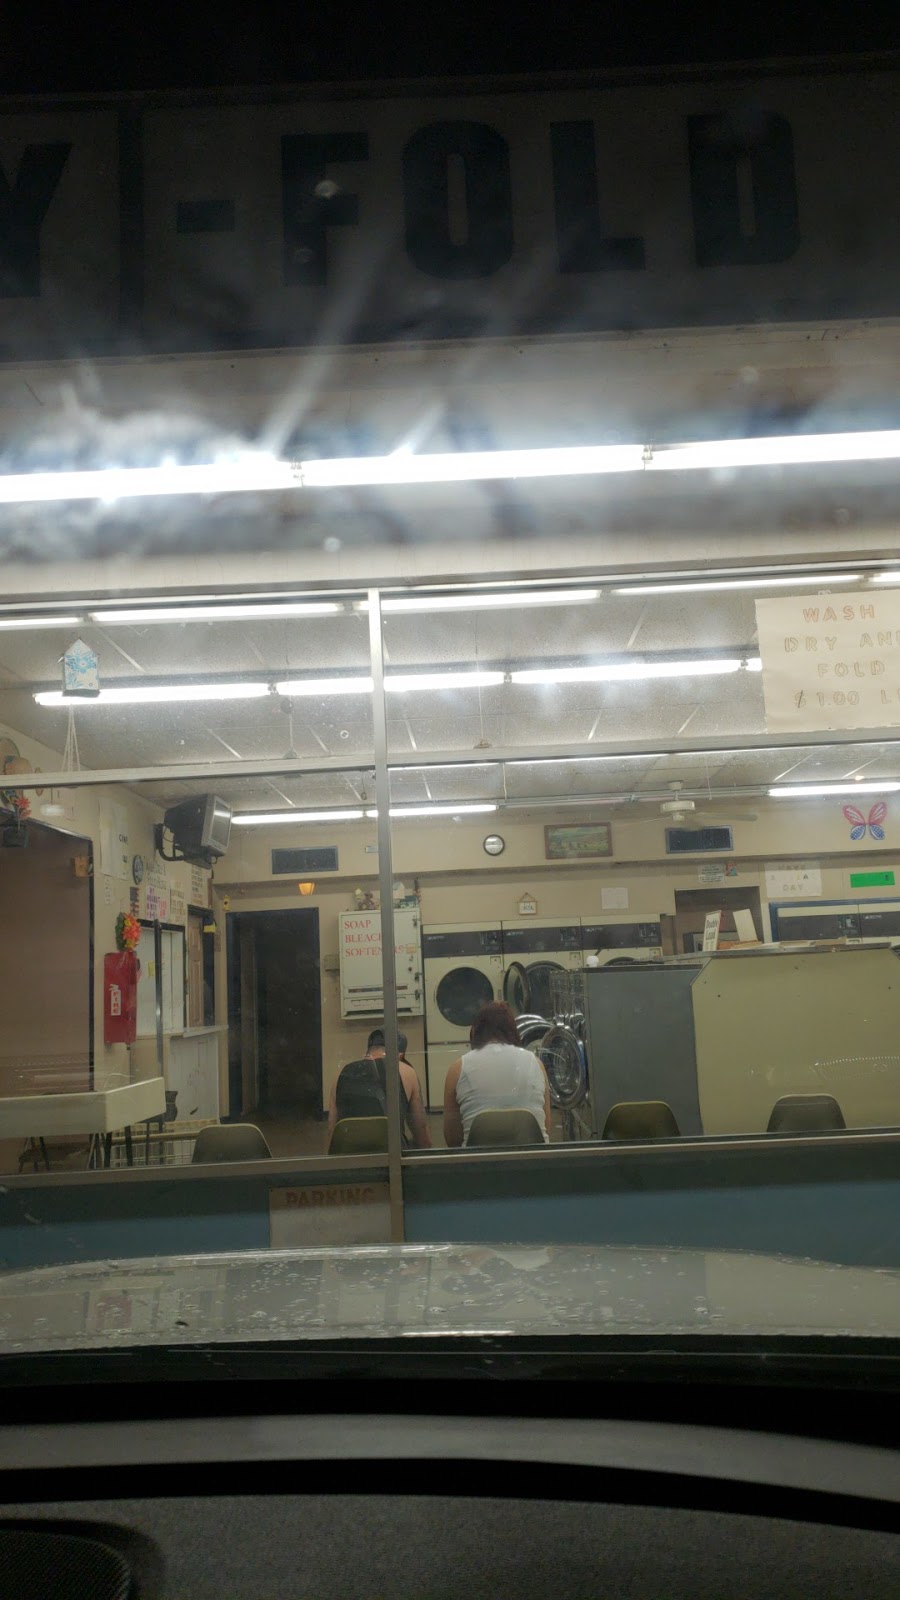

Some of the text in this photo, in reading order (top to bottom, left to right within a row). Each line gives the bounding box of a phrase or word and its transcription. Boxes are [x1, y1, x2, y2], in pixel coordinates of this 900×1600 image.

[802, 605, 875, 623] WASH
[784, 636, 838, 653] DRY
[817, 660, 886, 678] FOLD
[344, 919, 372, 930] SOAP
[285, 1188, 375, 1206] PARKING
